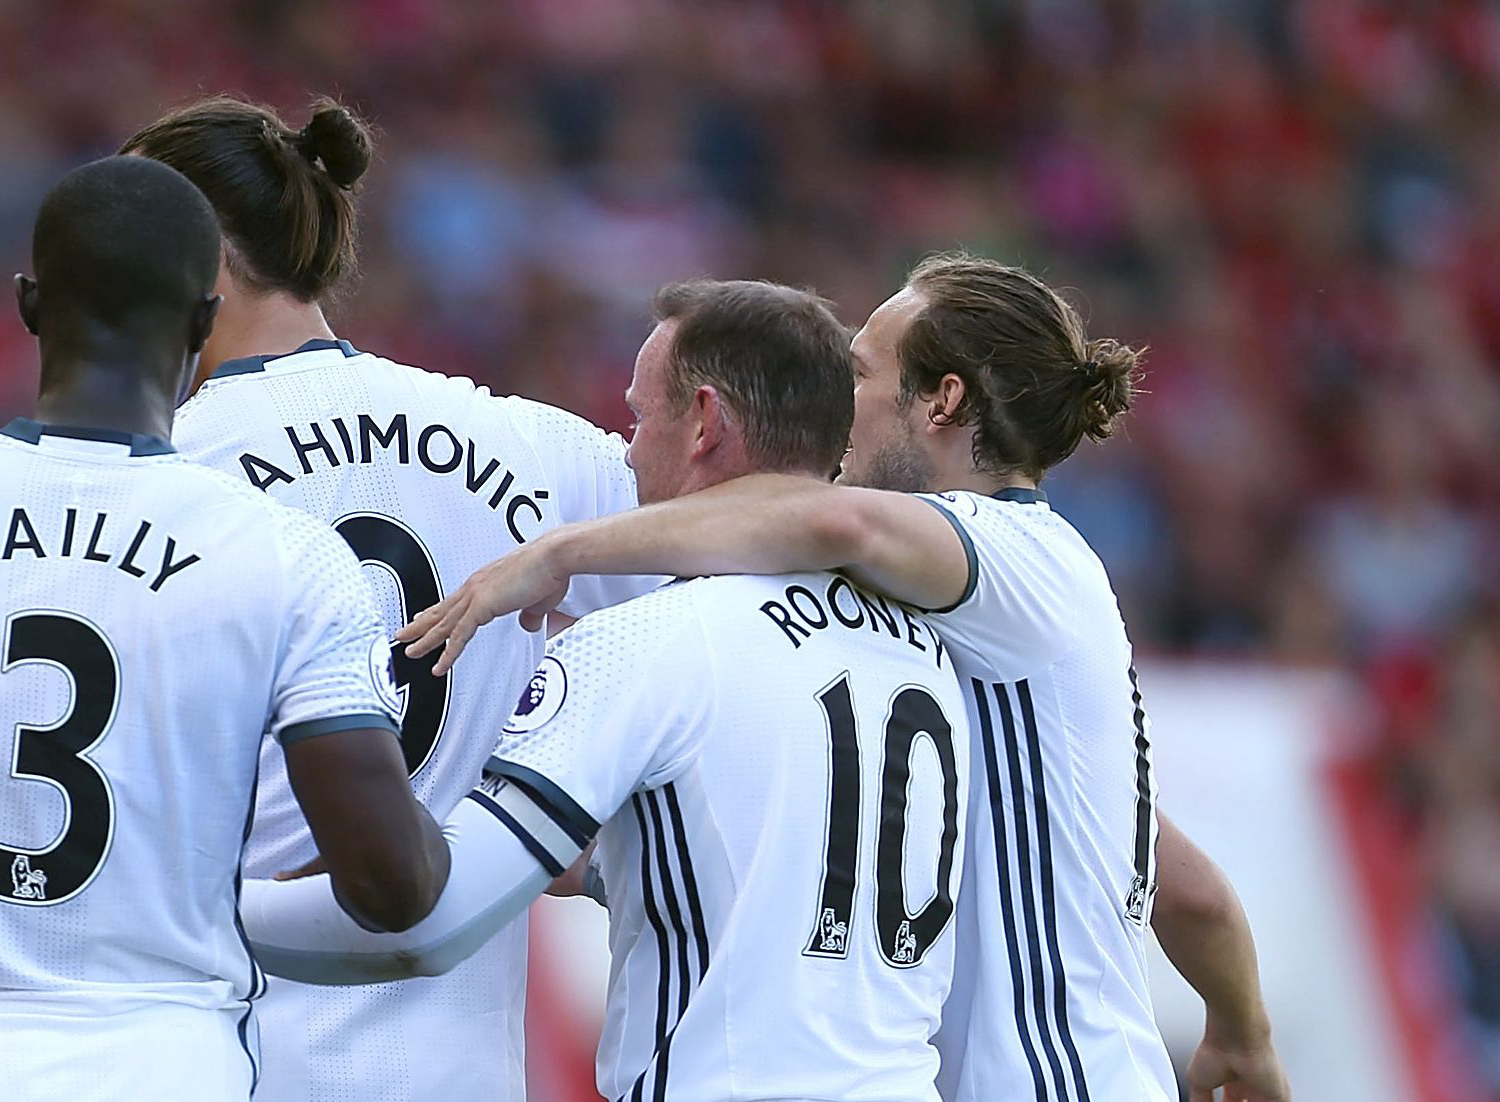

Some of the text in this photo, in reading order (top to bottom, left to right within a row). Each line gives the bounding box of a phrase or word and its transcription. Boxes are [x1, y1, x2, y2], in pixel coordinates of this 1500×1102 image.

[239, 413, 549, 545] AHIMOVIĆ
[759, 576, 944, 670] ROONEY
[801, 670, 959, 968] 10
